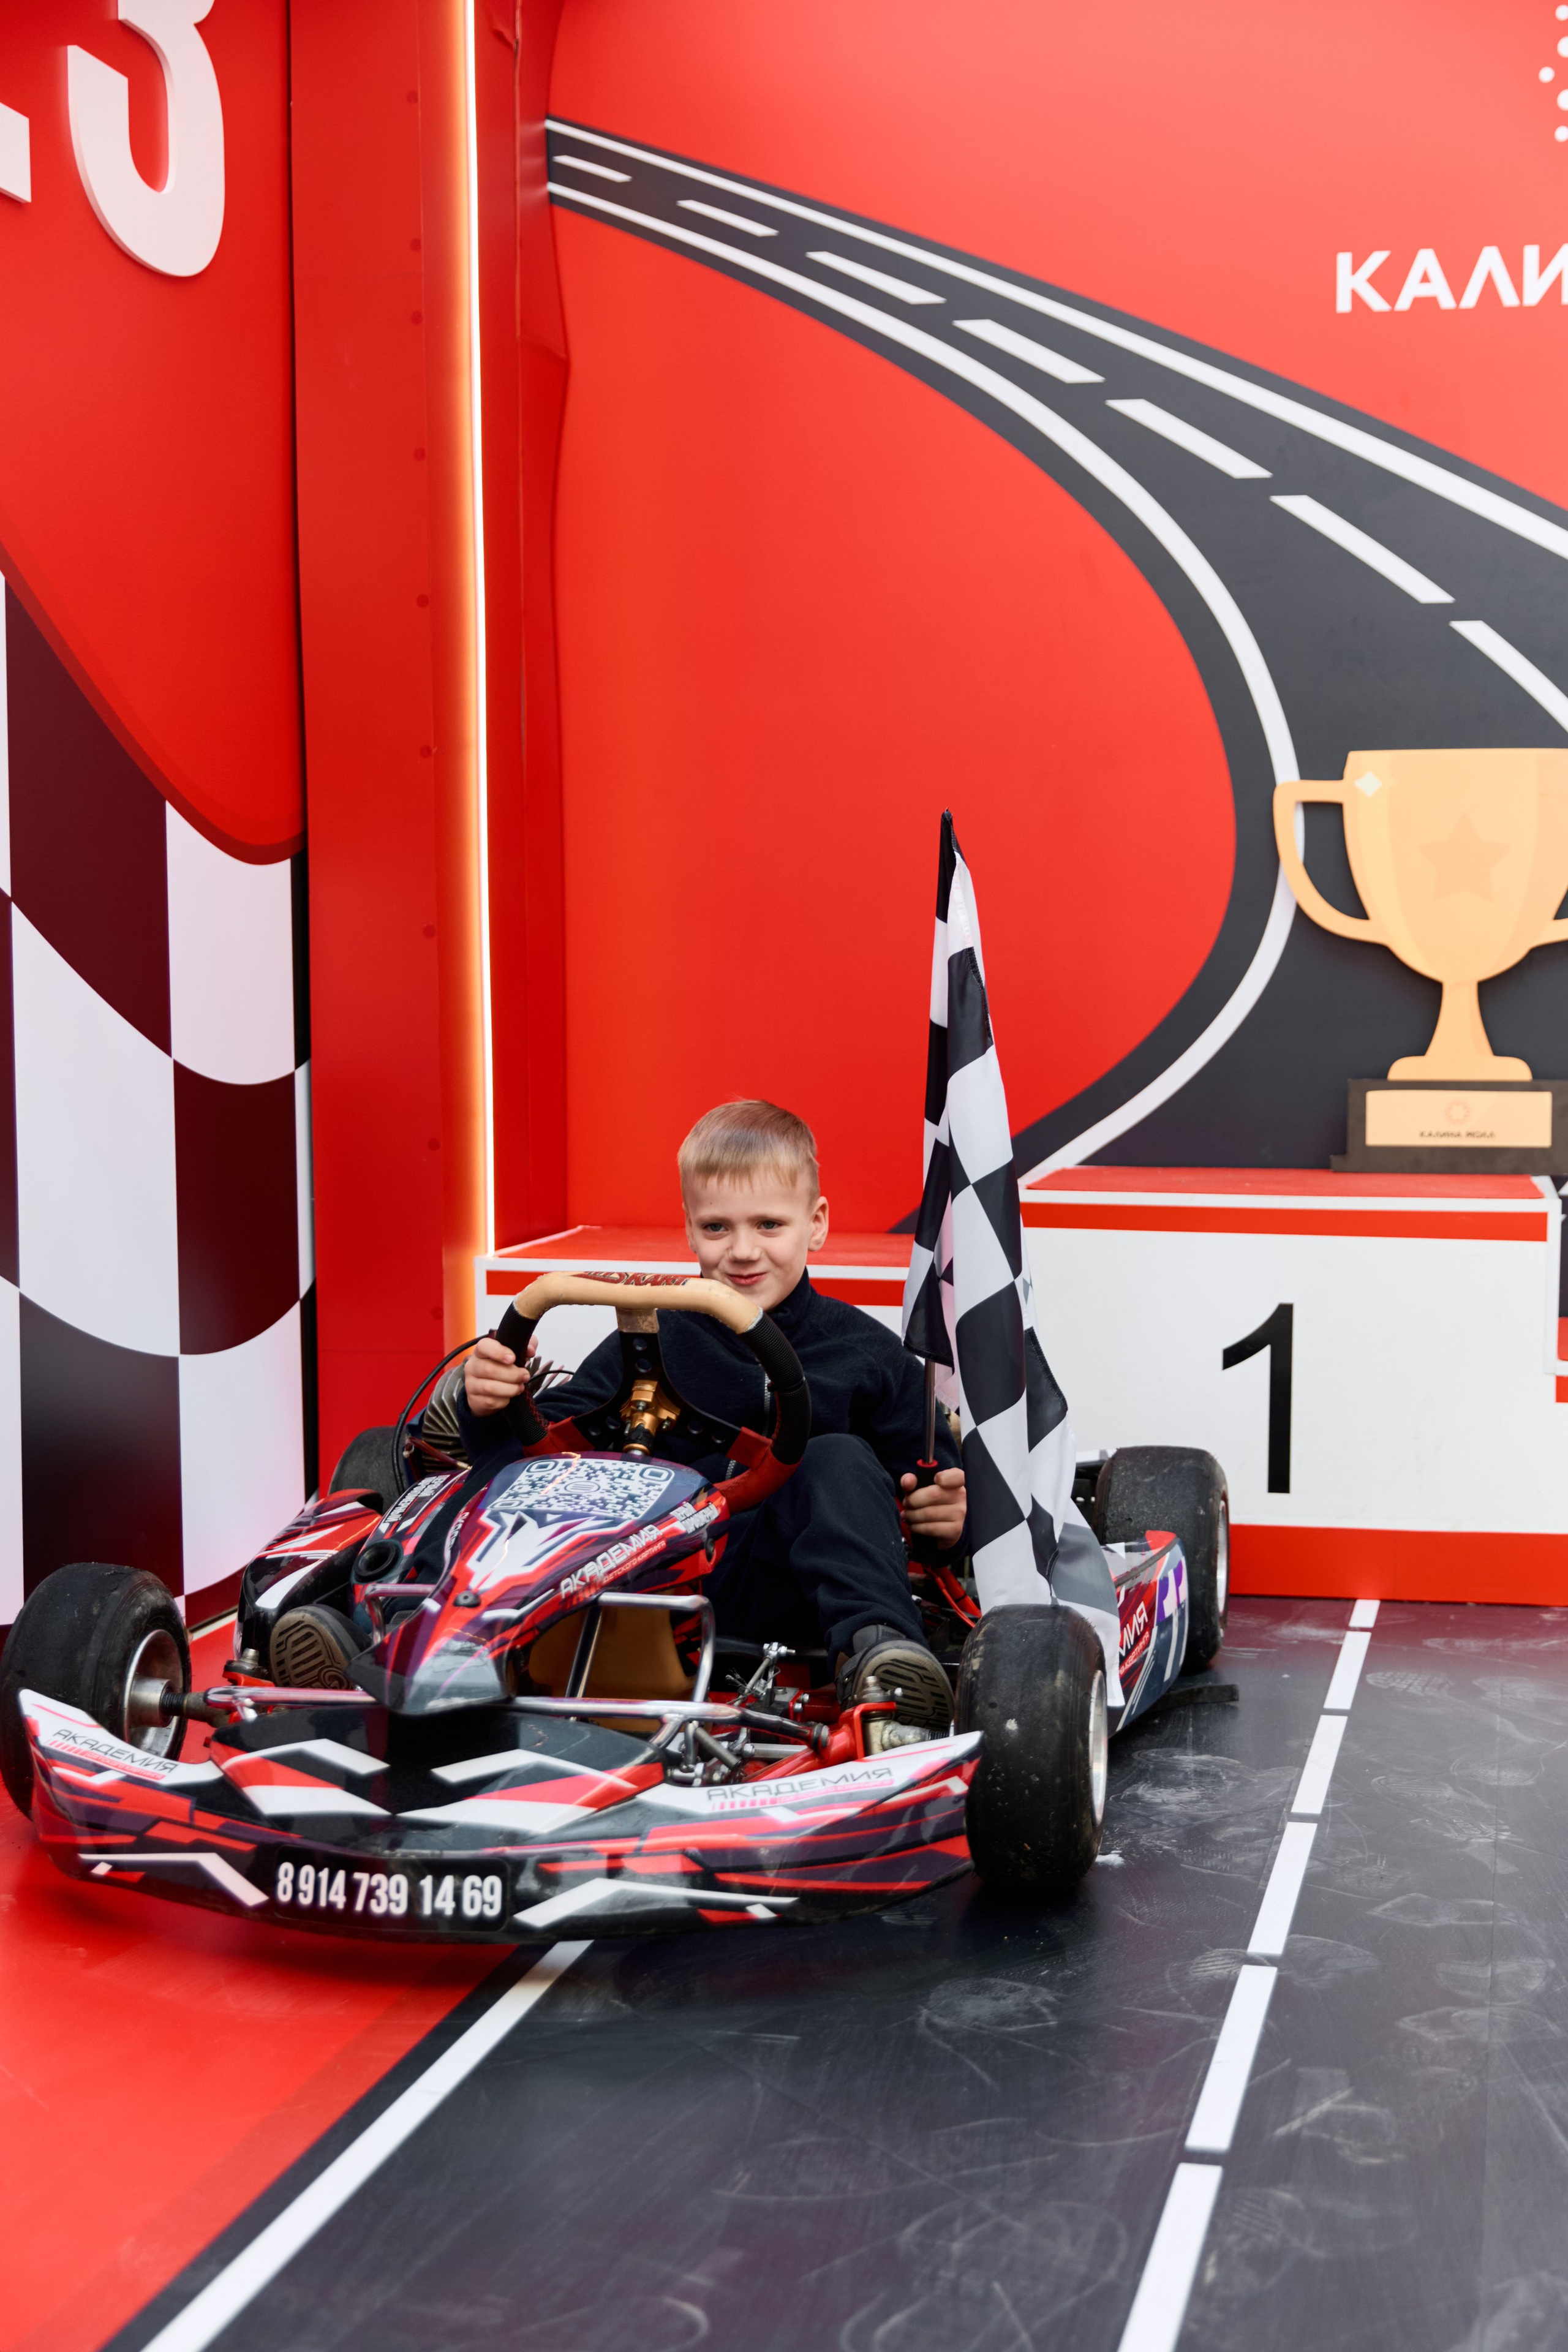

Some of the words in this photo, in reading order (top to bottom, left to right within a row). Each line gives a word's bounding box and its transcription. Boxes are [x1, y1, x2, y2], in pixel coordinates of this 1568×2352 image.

[1222, 1303, 1294, 1493] 1
[560, 1524, 663, 1599] АКАДЕМИЯ
[603, 1558, 638, 1583] ДЕТСКОГО
[637, 1540, 666, 1562] КАРТИНГА
[53, 1728, 179, 1773] АКАДЕМИЯ
[707, 1768, 893, 1801] АКАДЕМИЯ
[277, 1861, 295, 1902] 8
[298, 1864, 347, 1909] 914
[353, 1871, 409, 1915] 739
[419, 1874, 456, 1915] 14
[462, 1874, 502, 1916] 69
